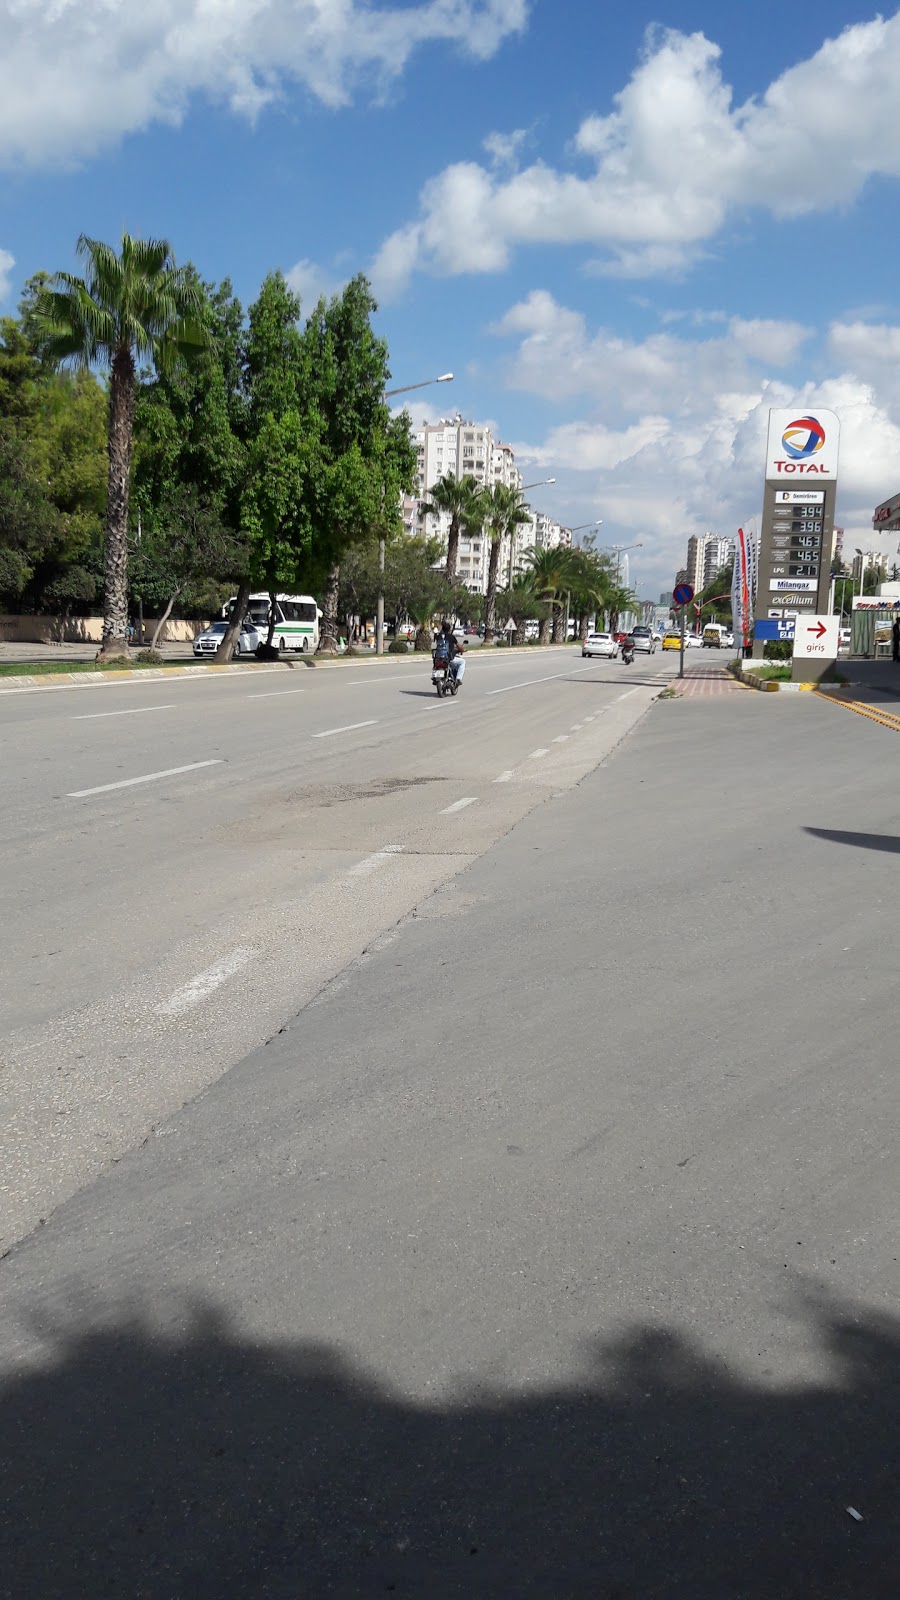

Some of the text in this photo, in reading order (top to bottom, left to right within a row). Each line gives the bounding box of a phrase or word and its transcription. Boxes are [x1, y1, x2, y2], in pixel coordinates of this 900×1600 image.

[773, 461, 830, 473] TOTAL
[801, 507, 823, 518] 3.94
[800, 522, 821, 532] 3.96
[798, 536, 820, 546] 4.63
[797, 551, 819, 561] 4.65
[777, 580, 810, 590] Milangaz
[771, 595, 814, 605] excellium
[777, 620, 795, 631] LP
[806, 643, 826, 653] giriş
